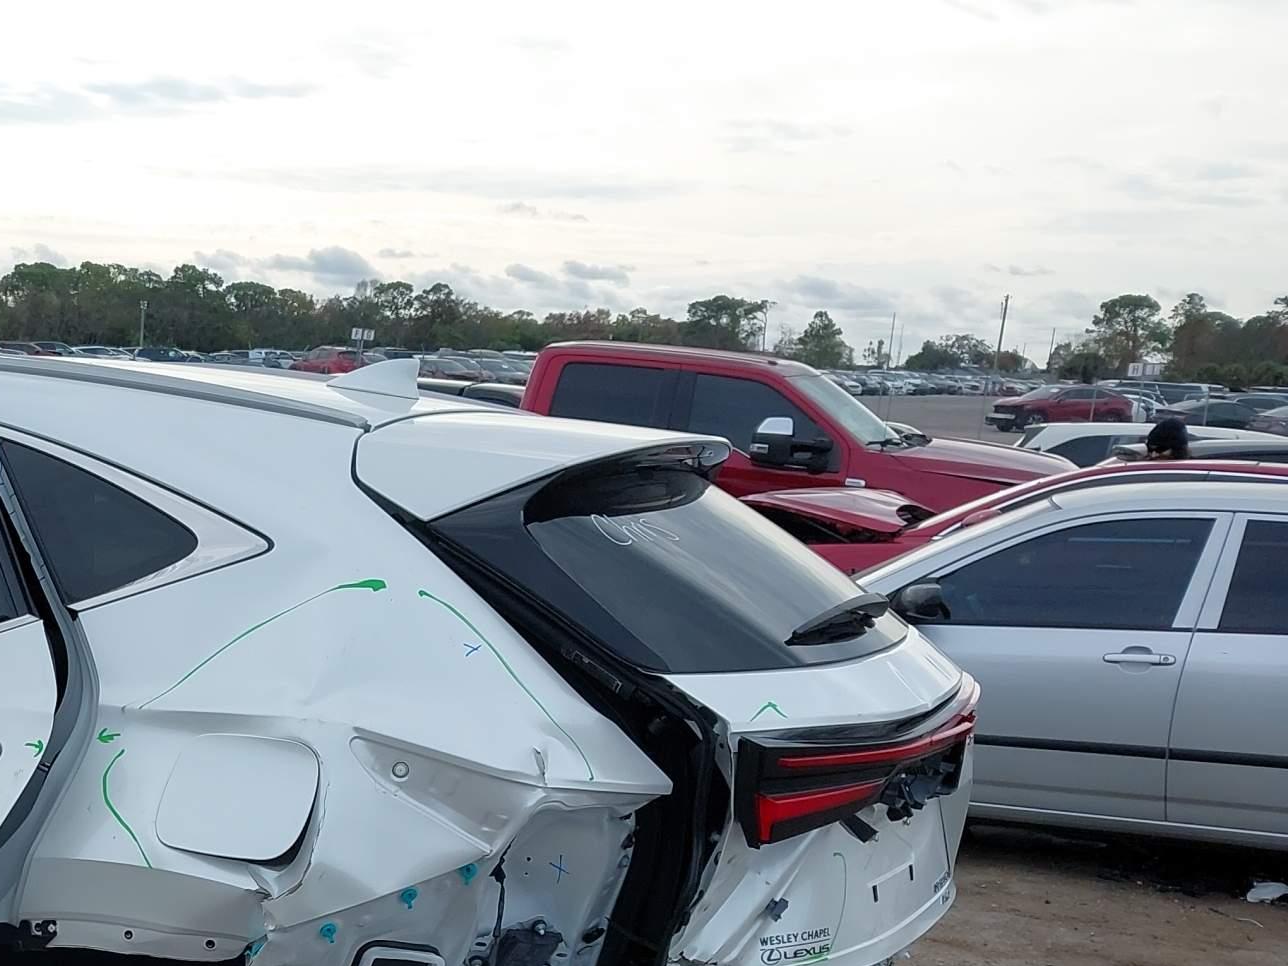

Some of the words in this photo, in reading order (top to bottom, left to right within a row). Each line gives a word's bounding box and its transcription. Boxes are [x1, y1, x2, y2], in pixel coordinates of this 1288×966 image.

[760, 932, 799, 947] WESLEY
[801, 927, 831, 942] CHAPEL
[783, 943, 831, 960] LEXUS
